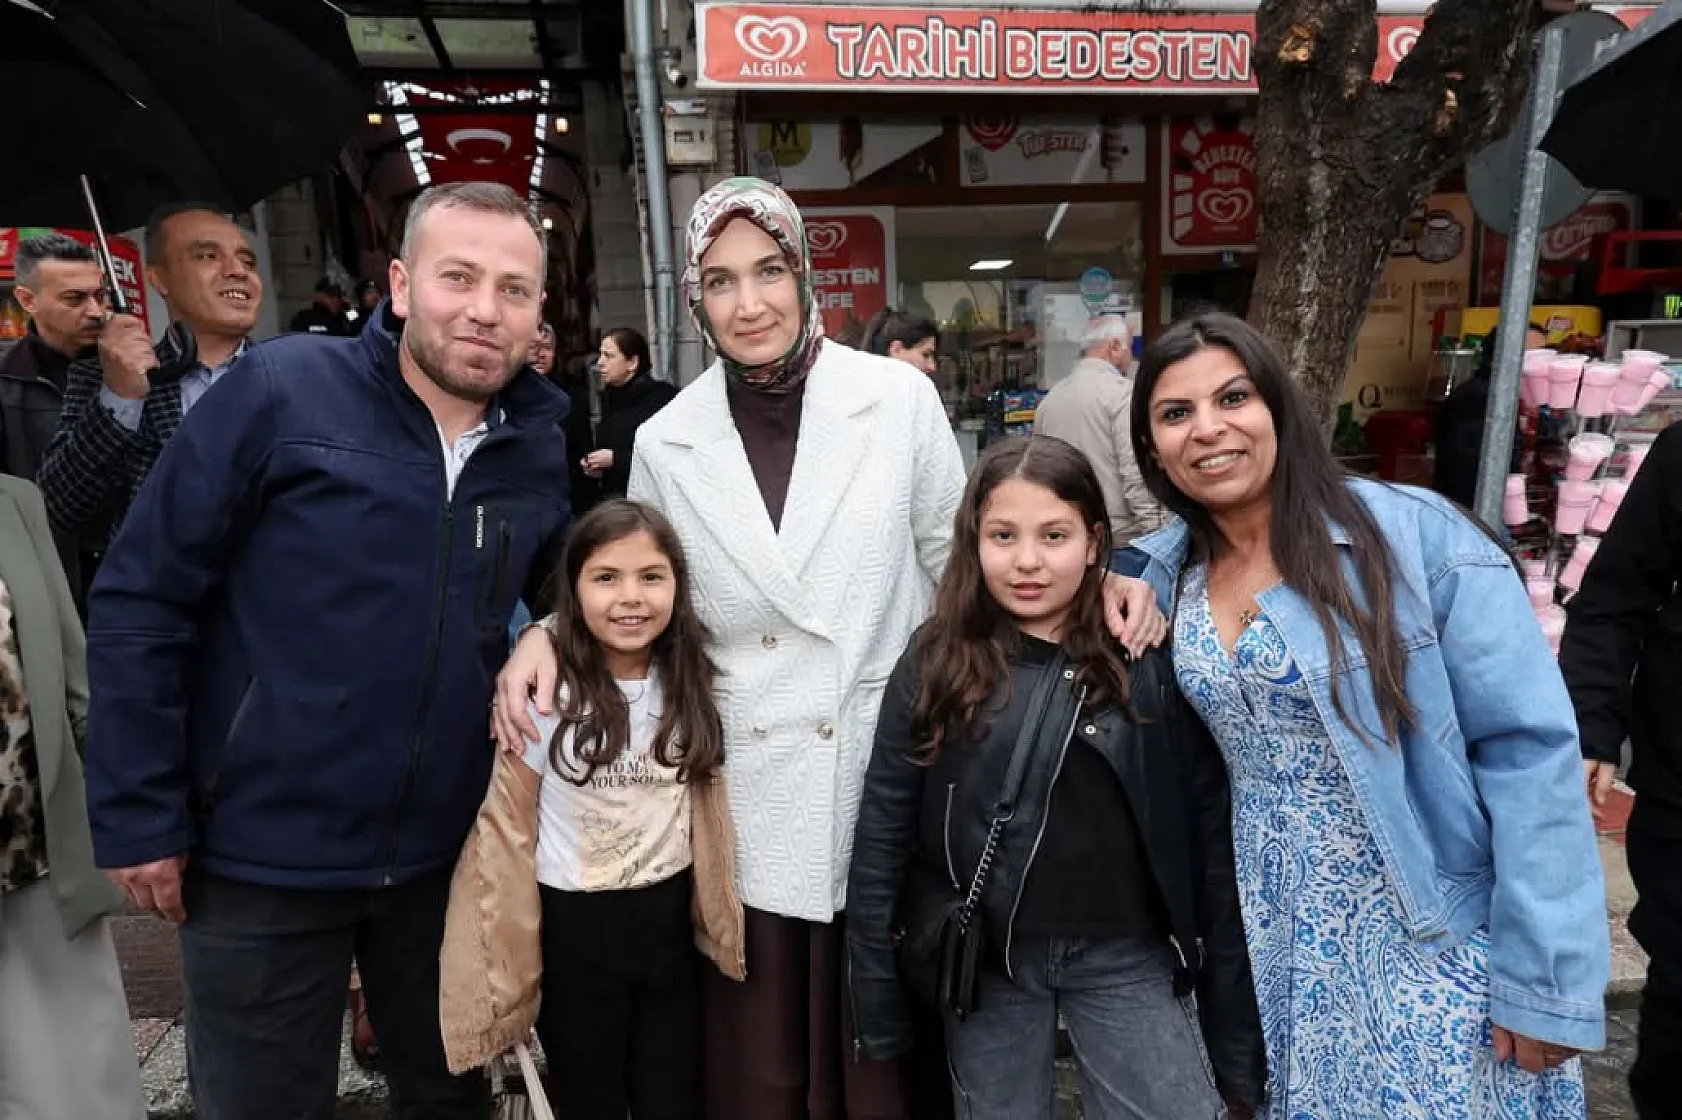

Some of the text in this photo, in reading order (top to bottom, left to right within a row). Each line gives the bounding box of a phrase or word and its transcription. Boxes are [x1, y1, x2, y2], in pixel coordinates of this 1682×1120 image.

[1004, 28, 1253, 82] BEDESTEN
[739, 61, 805, 77] ALGIDA
[591, 775, 627, 790] YOUR
